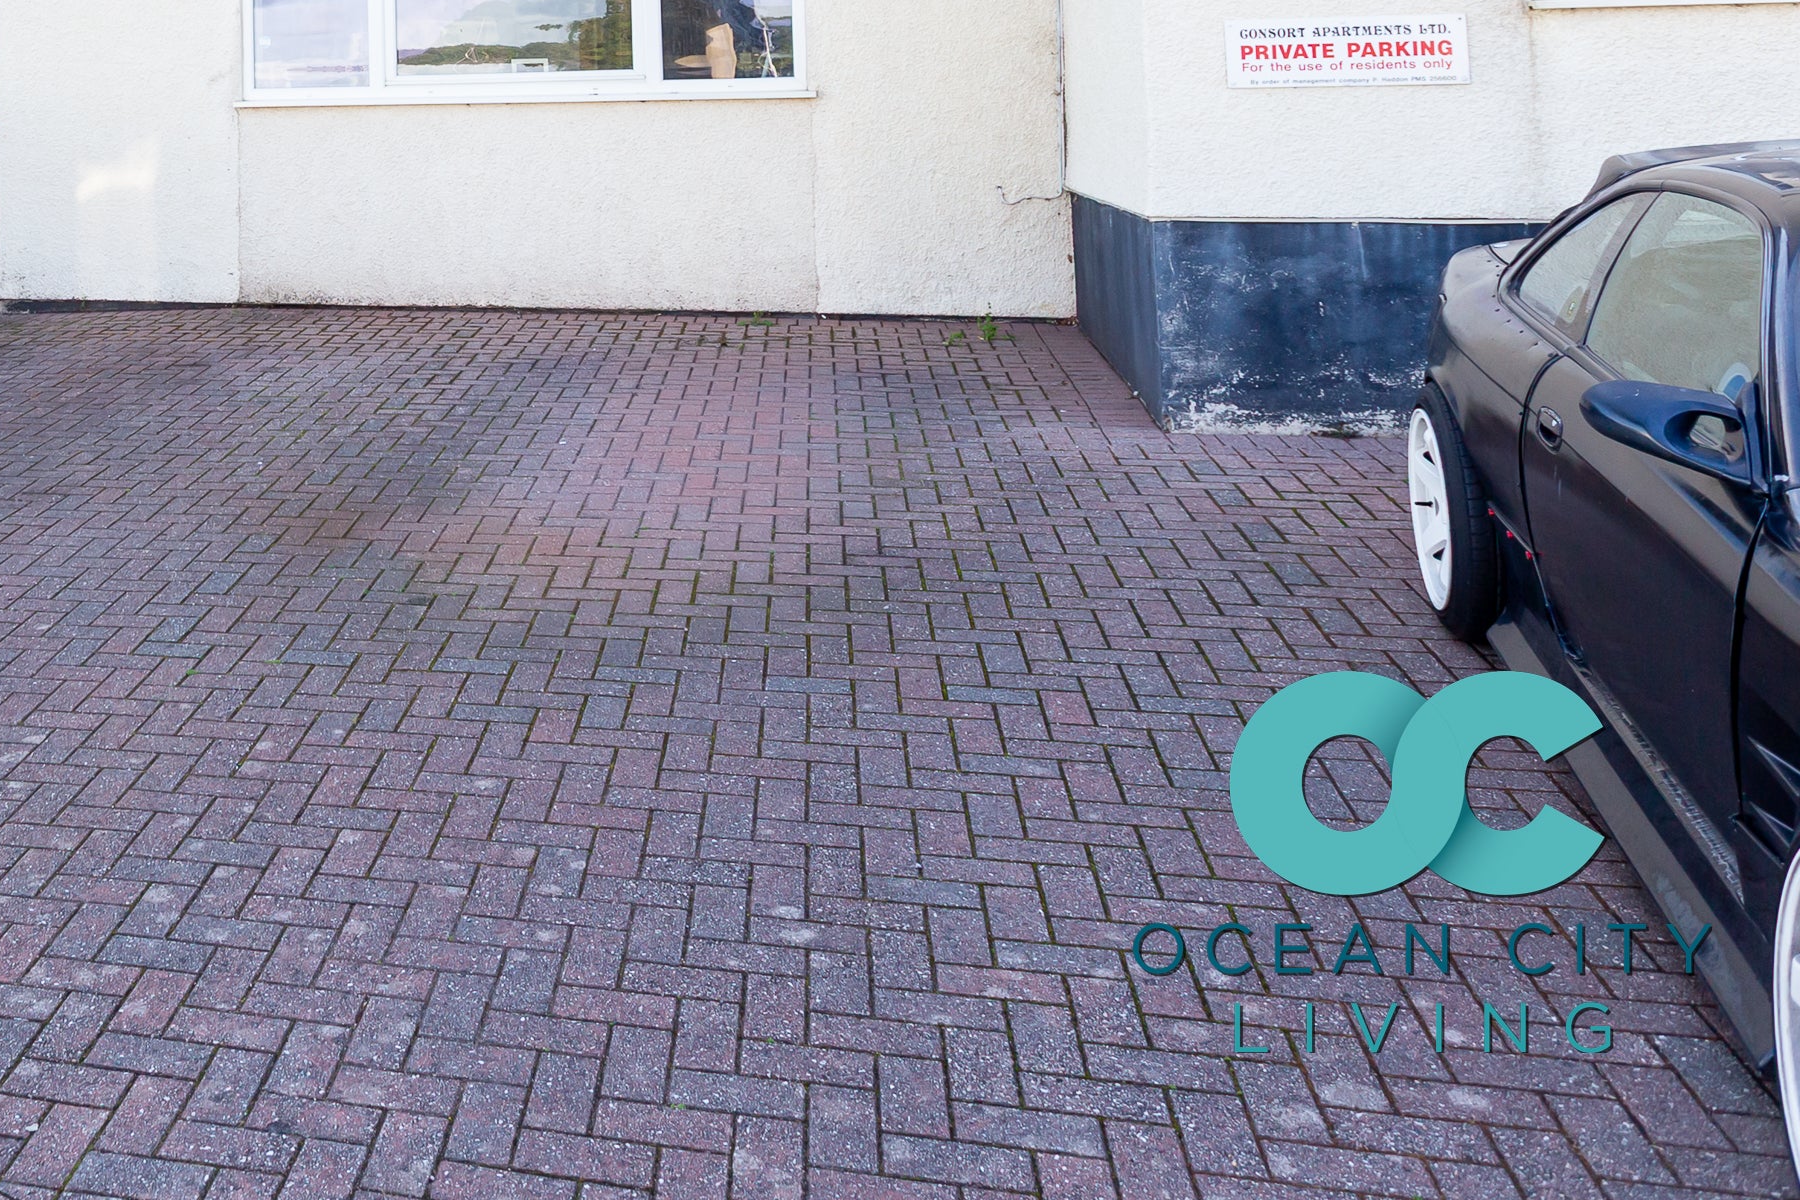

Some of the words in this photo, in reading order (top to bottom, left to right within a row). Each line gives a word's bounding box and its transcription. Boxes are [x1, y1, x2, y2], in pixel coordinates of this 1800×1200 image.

[1240, 27, 1305, 39] CONSORT
[1312, 24, 1412, 37] APARTMENTS
[1419, 23, 1452, 35] LTD.
[1240, 43, 1335, 60] PRIVATE
[1347, 40, 1453, 57] PARKING
[1242, 62, 1263, 72] For
[1271, 61, 1292, 71] the
[1299, 63, 1323, 71] use
[1330, 60, 1343, 71] of
[1350, 59, 1416, 70] residents
[1423, 58, 1453, 70] only
